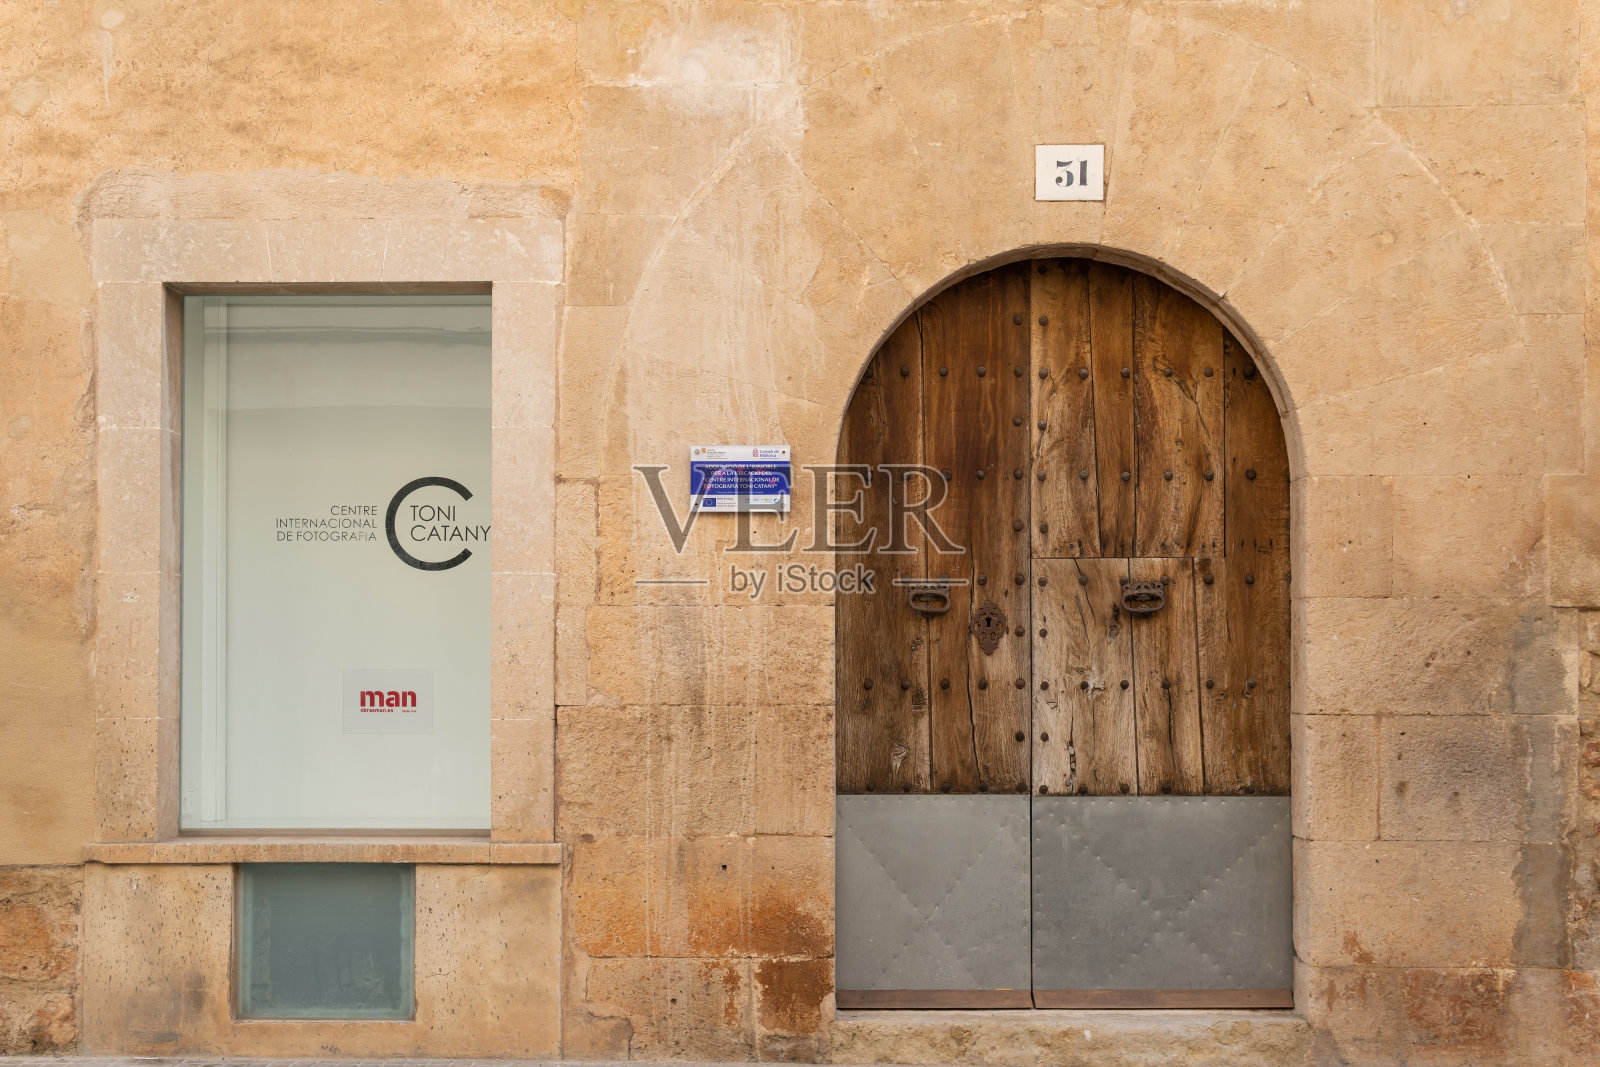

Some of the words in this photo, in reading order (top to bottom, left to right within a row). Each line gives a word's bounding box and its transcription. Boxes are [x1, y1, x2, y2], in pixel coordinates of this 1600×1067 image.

[1055, 160, 1088, 188] 31
[330, 505, 378, 516] CENTRE
[410, 505, 456, 522] TONI
[275, 518, 378, 529] INTERNACIONAL
[277, 531, 293, 542] DE
[296, 531, 377, 542] FOTOGRAFIA
[410, 525, 491, 542] CATANY
[360, 690, 417, 707] man
